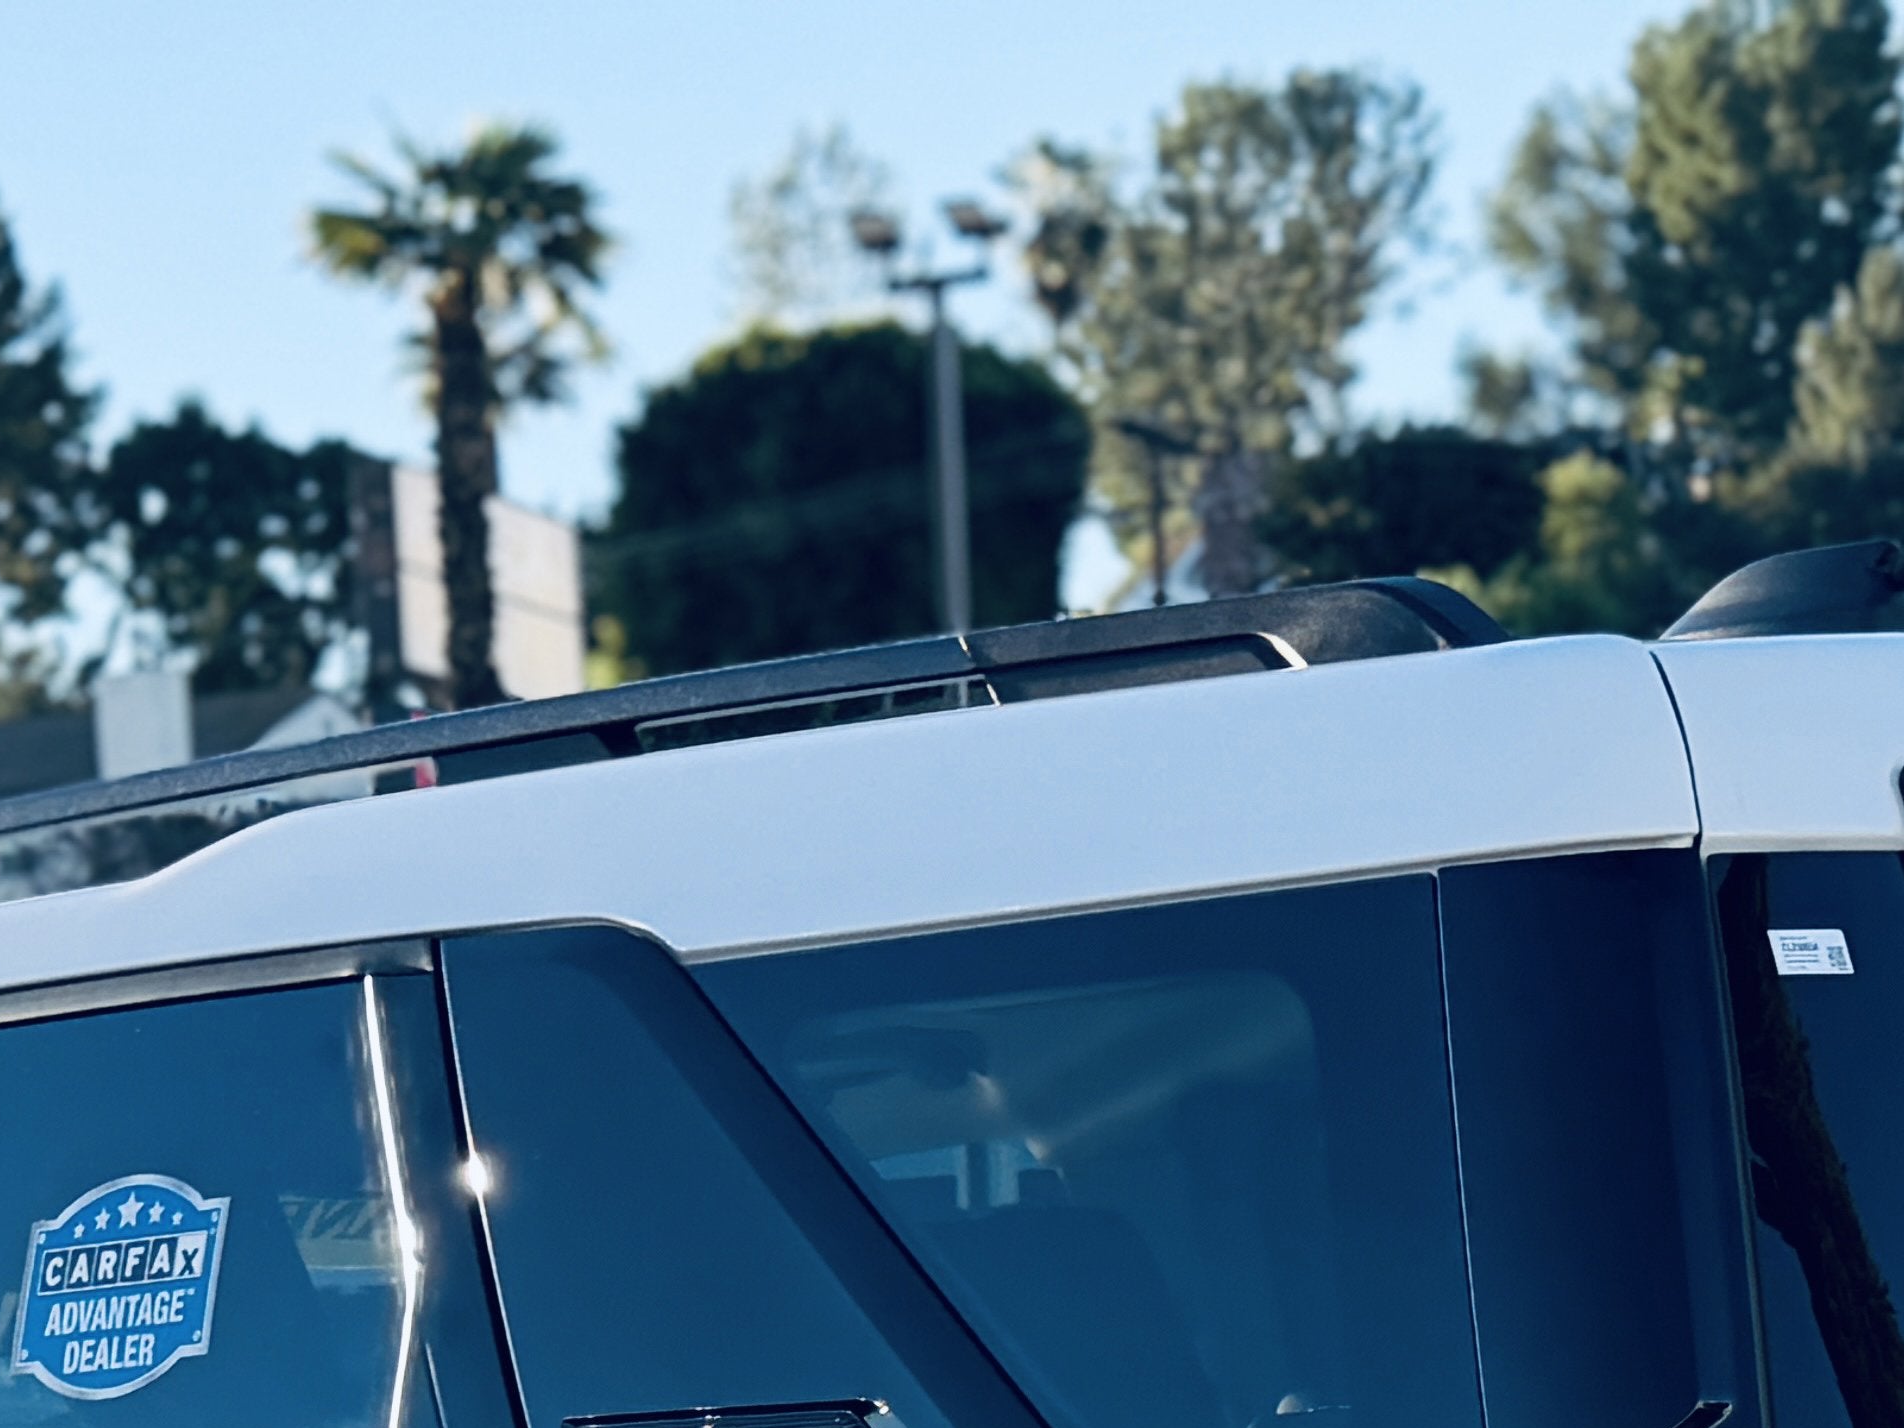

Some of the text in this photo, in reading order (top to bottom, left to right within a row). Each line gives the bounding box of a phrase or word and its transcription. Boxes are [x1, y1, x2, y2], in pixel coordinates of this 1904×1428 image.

[44, 1241, 200, 1288] CARFAX
[44, 1288, 186, 1336] ADVANTAGE
[63, 1333, 156, 1375] DEALER
